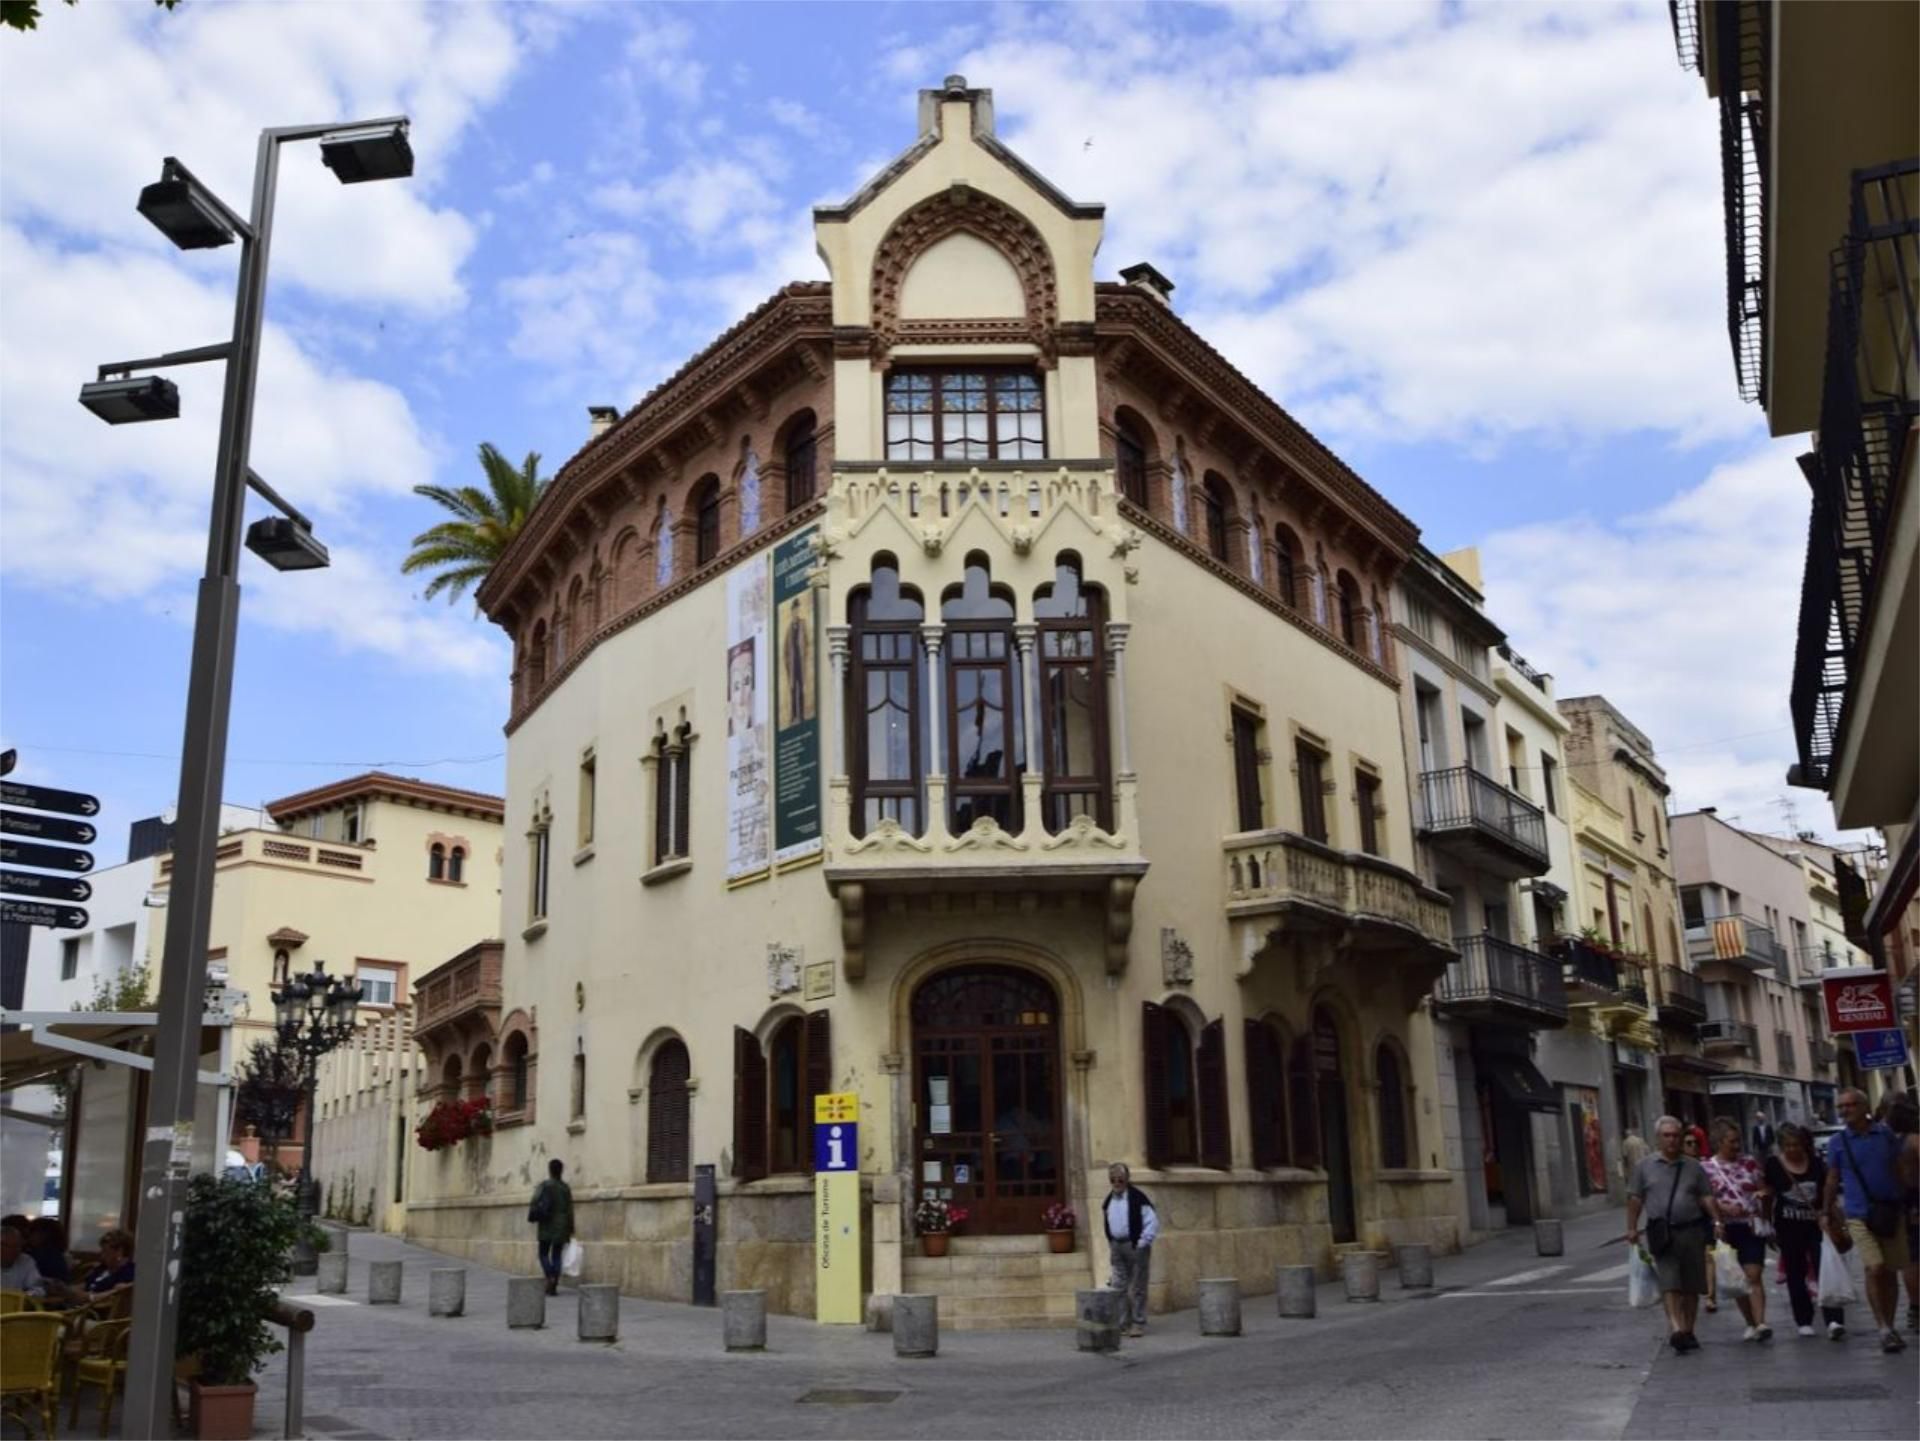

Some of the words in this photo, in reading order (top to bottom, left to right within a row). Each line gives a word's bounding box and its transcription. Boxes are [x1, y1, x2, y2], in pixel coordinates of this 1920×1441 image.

[1838, 1010, 1889, 1023] GENERALI
[822, 1178, 830, 1216] Turisme
[822, 1219, 830, 1232] de
[822, 1233, 830, 1269] Oficina
